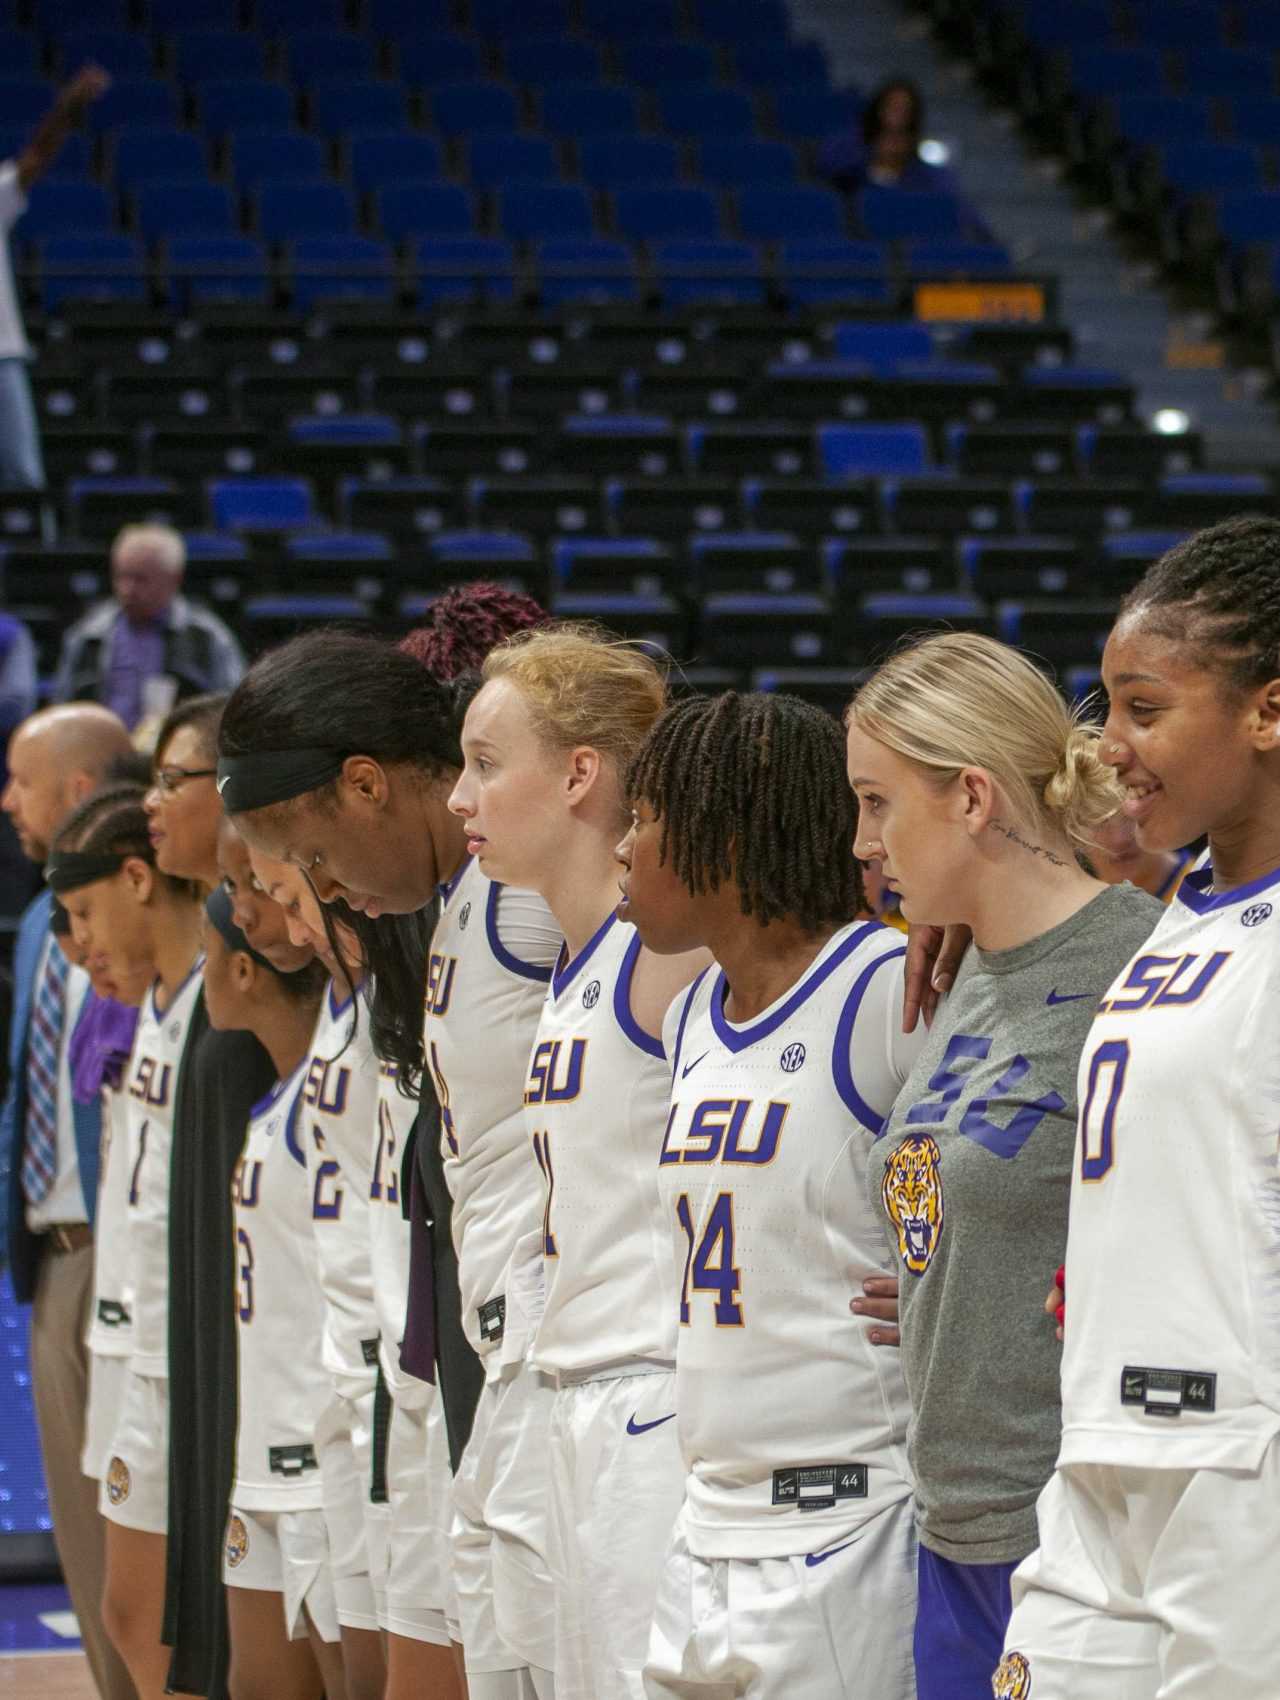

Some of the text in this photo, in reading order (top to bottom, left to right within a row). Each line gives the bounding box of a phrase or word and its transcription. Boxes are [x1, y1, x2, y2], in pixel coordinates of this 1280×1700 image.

[1095, 950, 1232, 1015] SU
[523, 1038, 588, 1107] SU
[658, 1099, 790, 1167] LSU
[676, 1191, 745, 1328] 14
[1188, 1382, 1207, 1400] 44
[840, 1473, 859, 1488] 44
